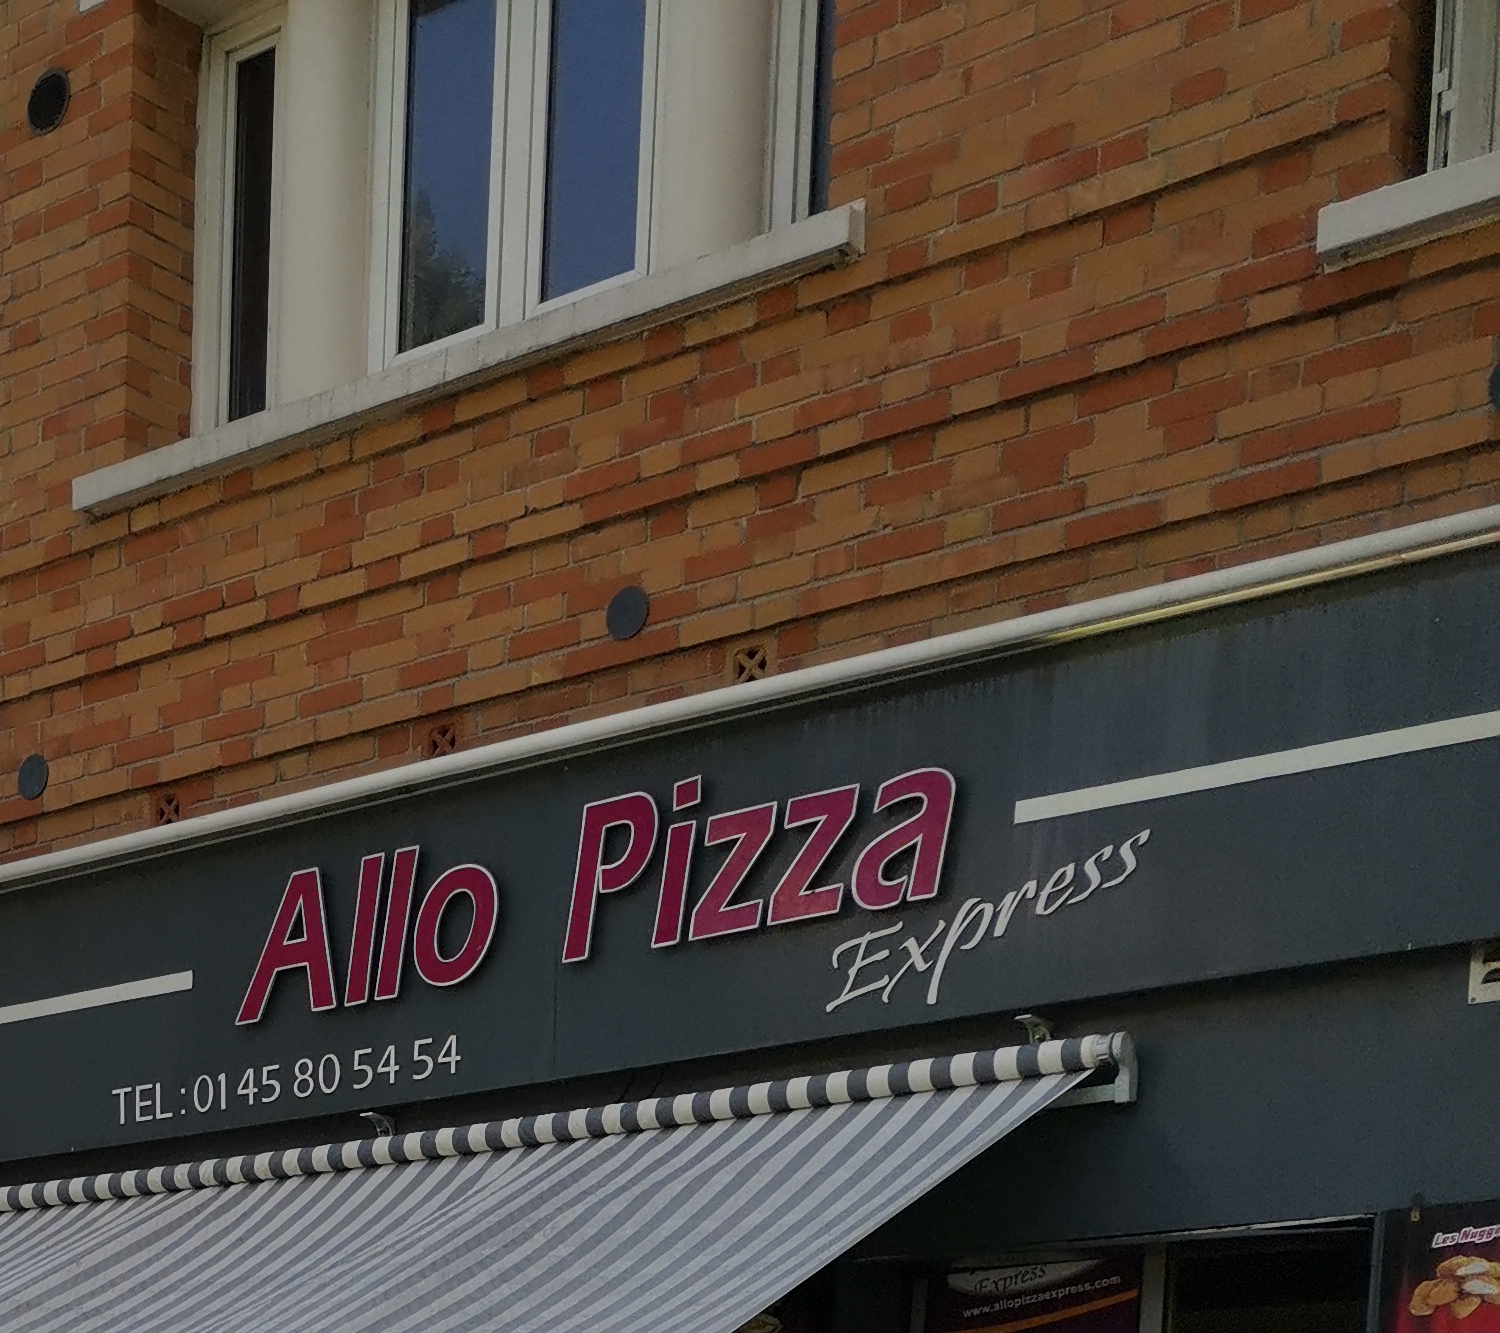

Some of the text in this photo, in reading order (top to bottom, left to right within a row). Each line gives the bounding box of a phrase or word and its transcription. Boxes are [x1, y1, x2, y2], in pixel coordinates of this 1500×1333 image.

[235, 766, 957, 1026] Allo Pizza
[825, 827, 1151, 1013] Express
[192, 1072, 228, 1115] 01
[236, 1064, 282, 1107] 45
[292, 1053, 341, 1099] 80
[352, 1044, 400, 1091] 54
[412, 1033, 462, 1081] 54
[1431, 1232, 1459, 1248] Les
[962, 1275, 1122, 1318] www.allopizzaexpress.com
[974, 1264, 1048, 1294] Express
